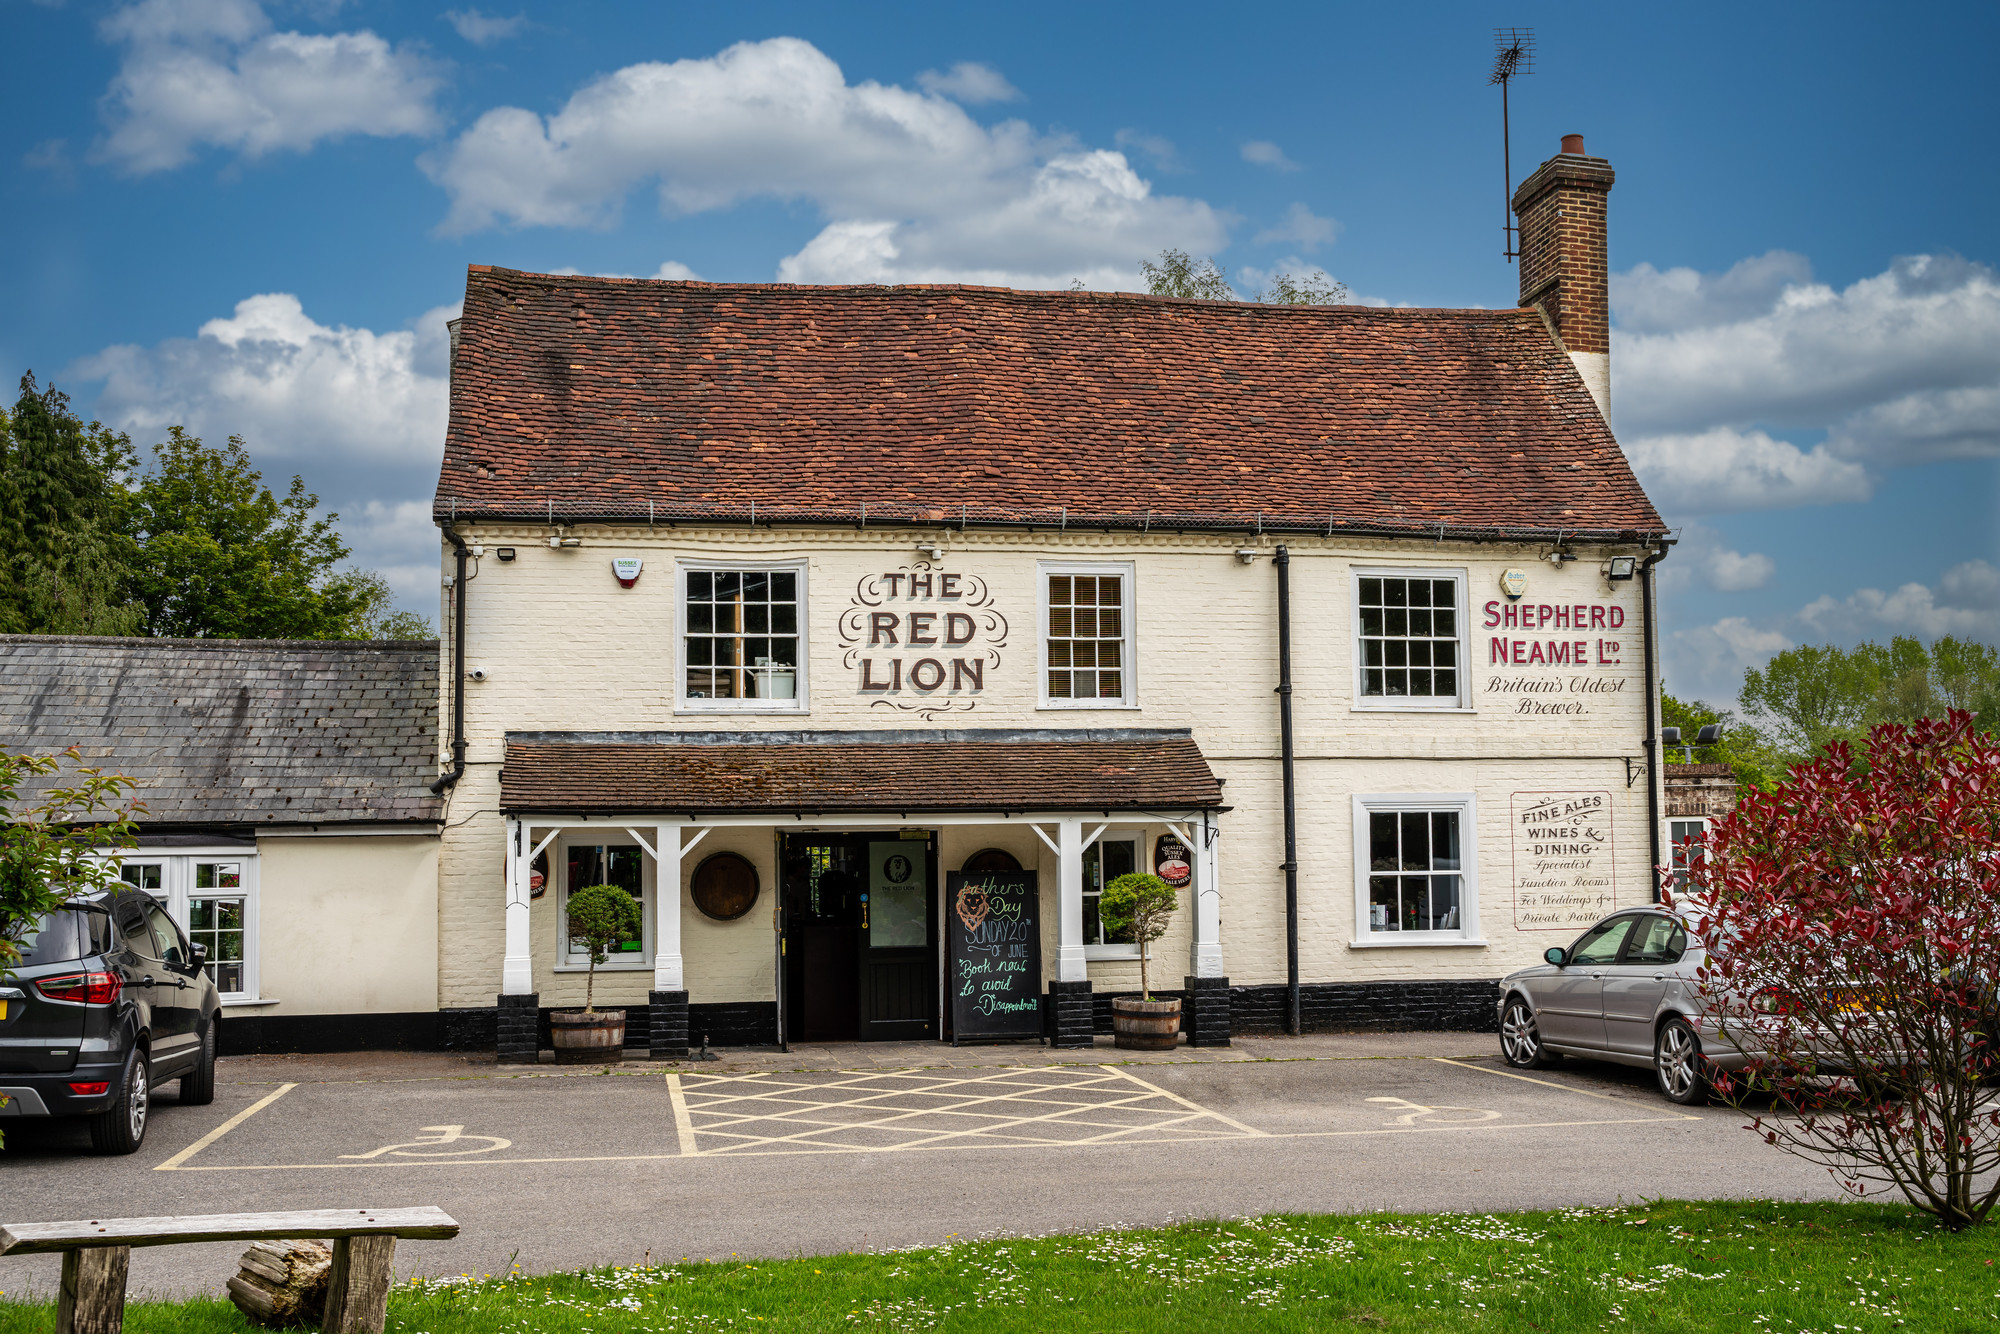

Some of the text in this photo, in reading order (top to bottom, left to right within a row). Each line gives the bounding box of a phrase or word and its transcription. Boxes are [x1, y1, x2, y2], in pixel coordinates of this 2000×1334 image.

[880, 573, 963, 600] THE
[1482, 600, 1625, 630] SHEPHERD
[868, 612, 976, 647] RED
[1489, 637, 1588, 666] NEAME
[858, 658, 984, 694] LION
[1484, 676, 1626, 693] Britain's Oldest
[1515, 698, 1589, 715] Brewer.
[1522, 796, 1602, 824] FINE ALES
[1528, 827, 1605, 842] WINES &
[1533, 859, 1592, 875] Specialist
[1519, 875, 1610, 888] Function Rooms
[988, 896, 1022, 922] Day
[1519, 893, 1612, 908] For Weddings &
[1519, 913, 1561, 923] Private
[965, 919, 1009, 944] SUNDAY
[991, 943, 1029, 958] OF JUNE
[959, 958, 1027, 979] Book now
[960, 975, 1013, 996] to avoid
